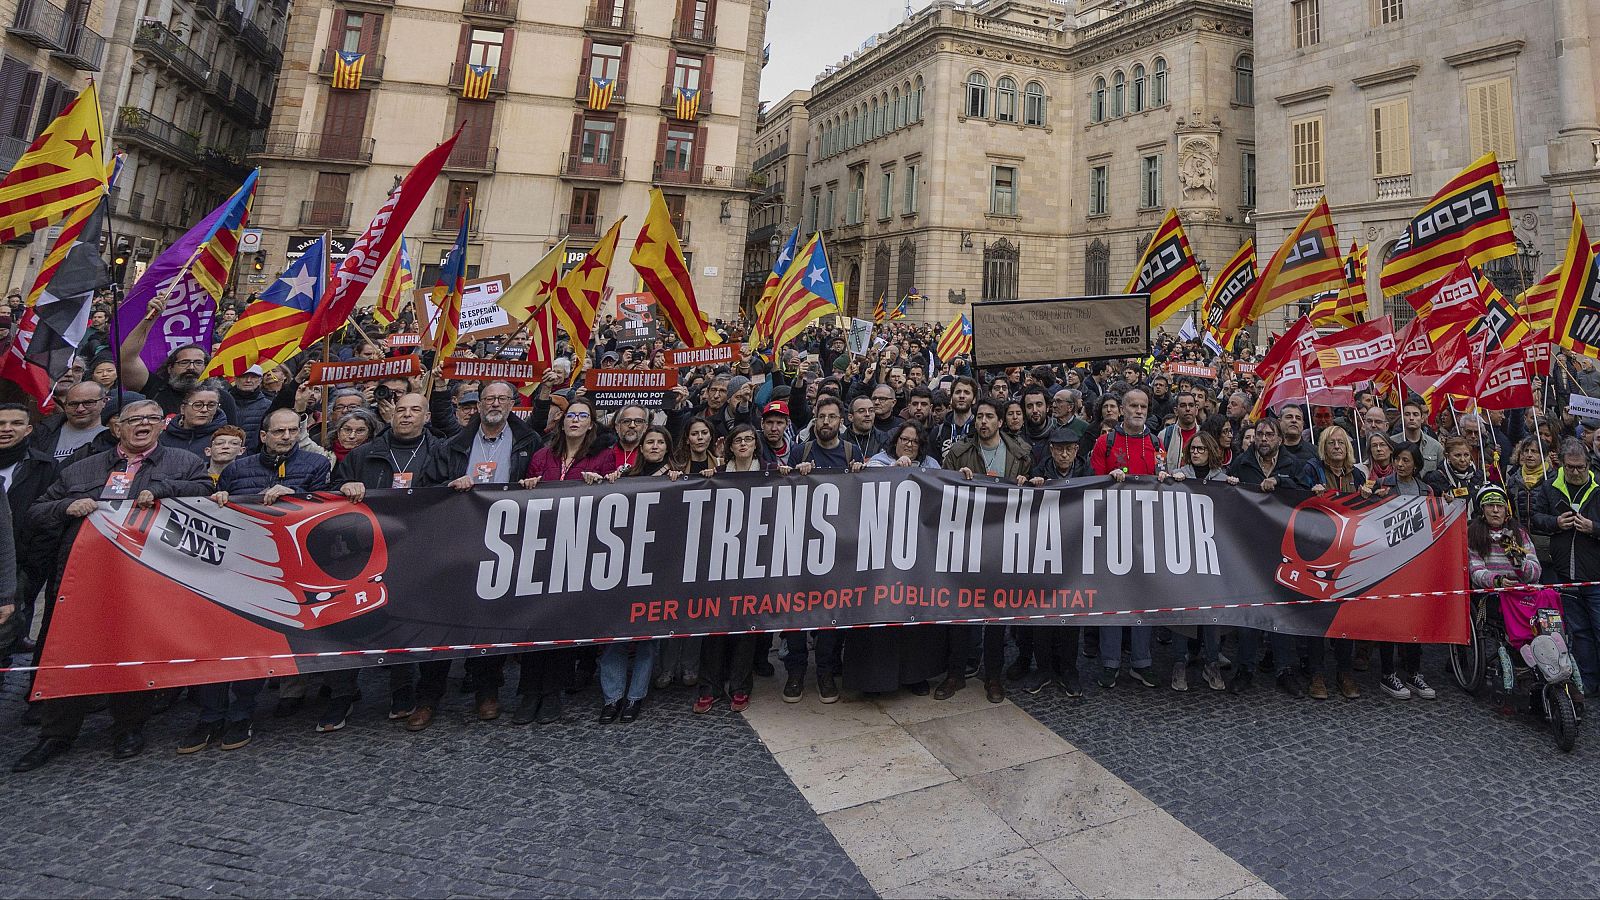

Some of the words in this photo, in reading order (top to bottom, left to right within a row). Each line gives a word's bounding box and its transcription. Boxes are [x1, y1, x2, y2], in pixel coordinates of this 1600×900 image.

[297, 238, 346, 252] BARCONA
[1105, 325, 1140, 337] SALVEM
[673, 345, 732, 365] INDEPENDÈNCIA
[320, 358, 413, 382] INDEPENDÈNCIA
[455, 360, 534, 379] INDEPENDÈNCIA
[595, 371, 666, 387] INDEPENDÈNCIA
[475, 491, 661, 600] SENSE
[682, 482, 841, 583] TRENS
[855, 479, 922, 572] NO
[935, 484, 987, 574] HI
[1001, 488, 1064, 575] HA
[1082, 489, 1221, 576] FUTUR
[355, 591, 367, 605] R
[629, 598, 679, 623] PER
[686, 596, 722, 619] UN
[729, 586, 867, 616] TRANSPORT
[873, 581, 950, 608] PÚBLIC
[957, 588, 985, 608] DE
[993, 588, 1098, 609] QUALITAT
